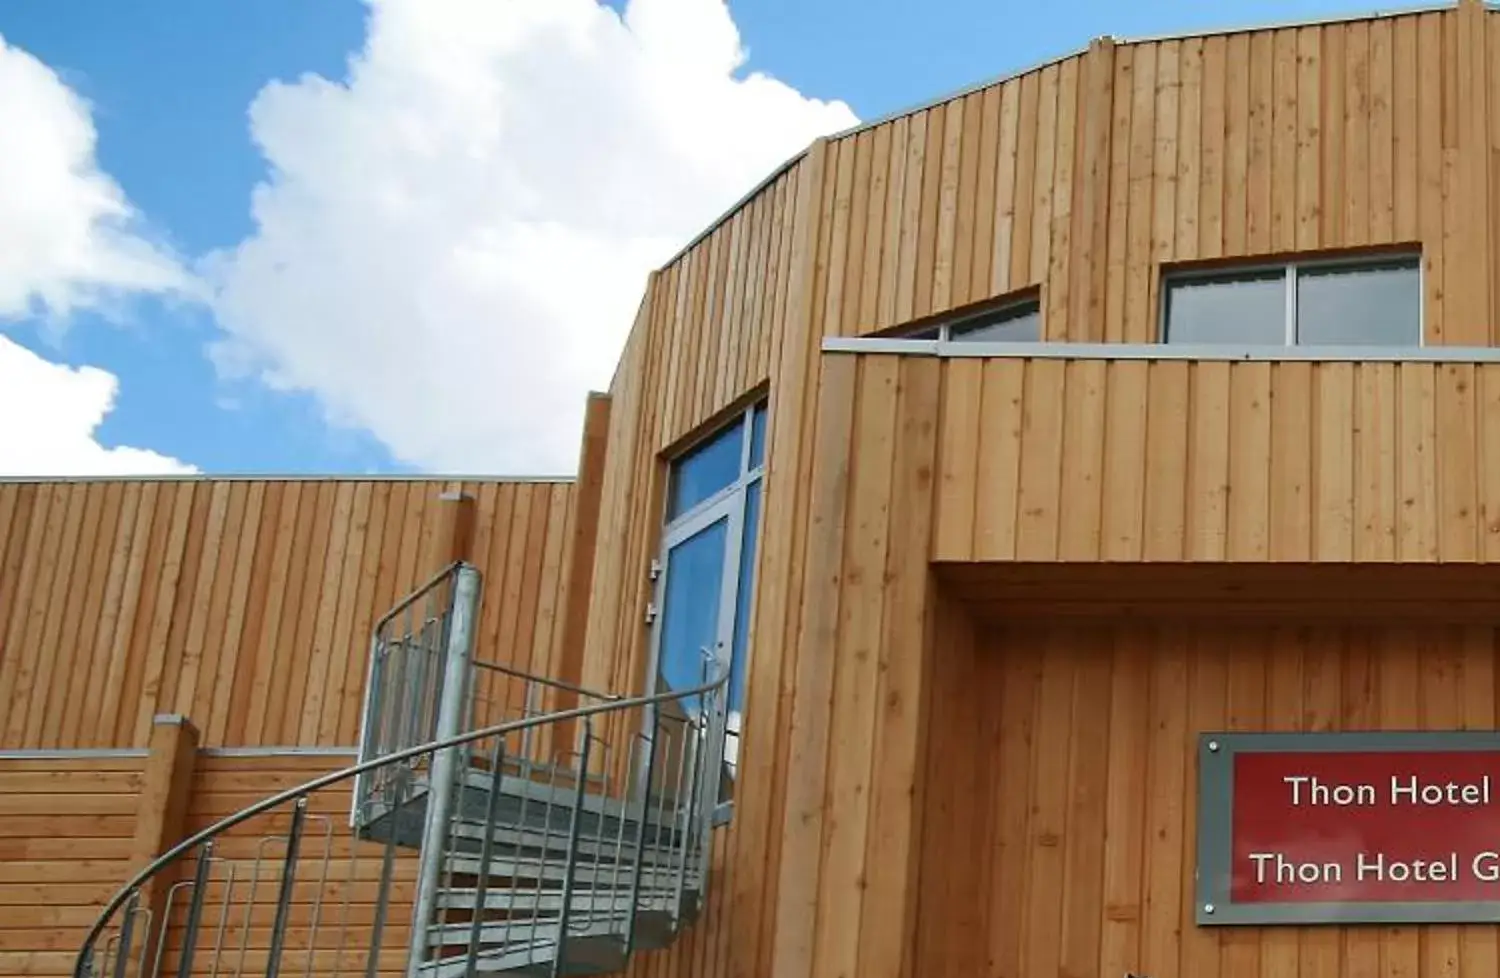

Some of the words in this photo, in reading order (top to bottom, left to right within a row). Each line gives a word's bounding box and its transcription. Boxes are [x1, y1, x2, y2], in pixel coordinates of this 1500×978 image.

[1284, 776, 1375, 805] Thon
[1390, 775, 1489, 805] Hotel
[1249, 853, 1342, 884] Thon
[1357, 853, 1458, 882] Hotel
